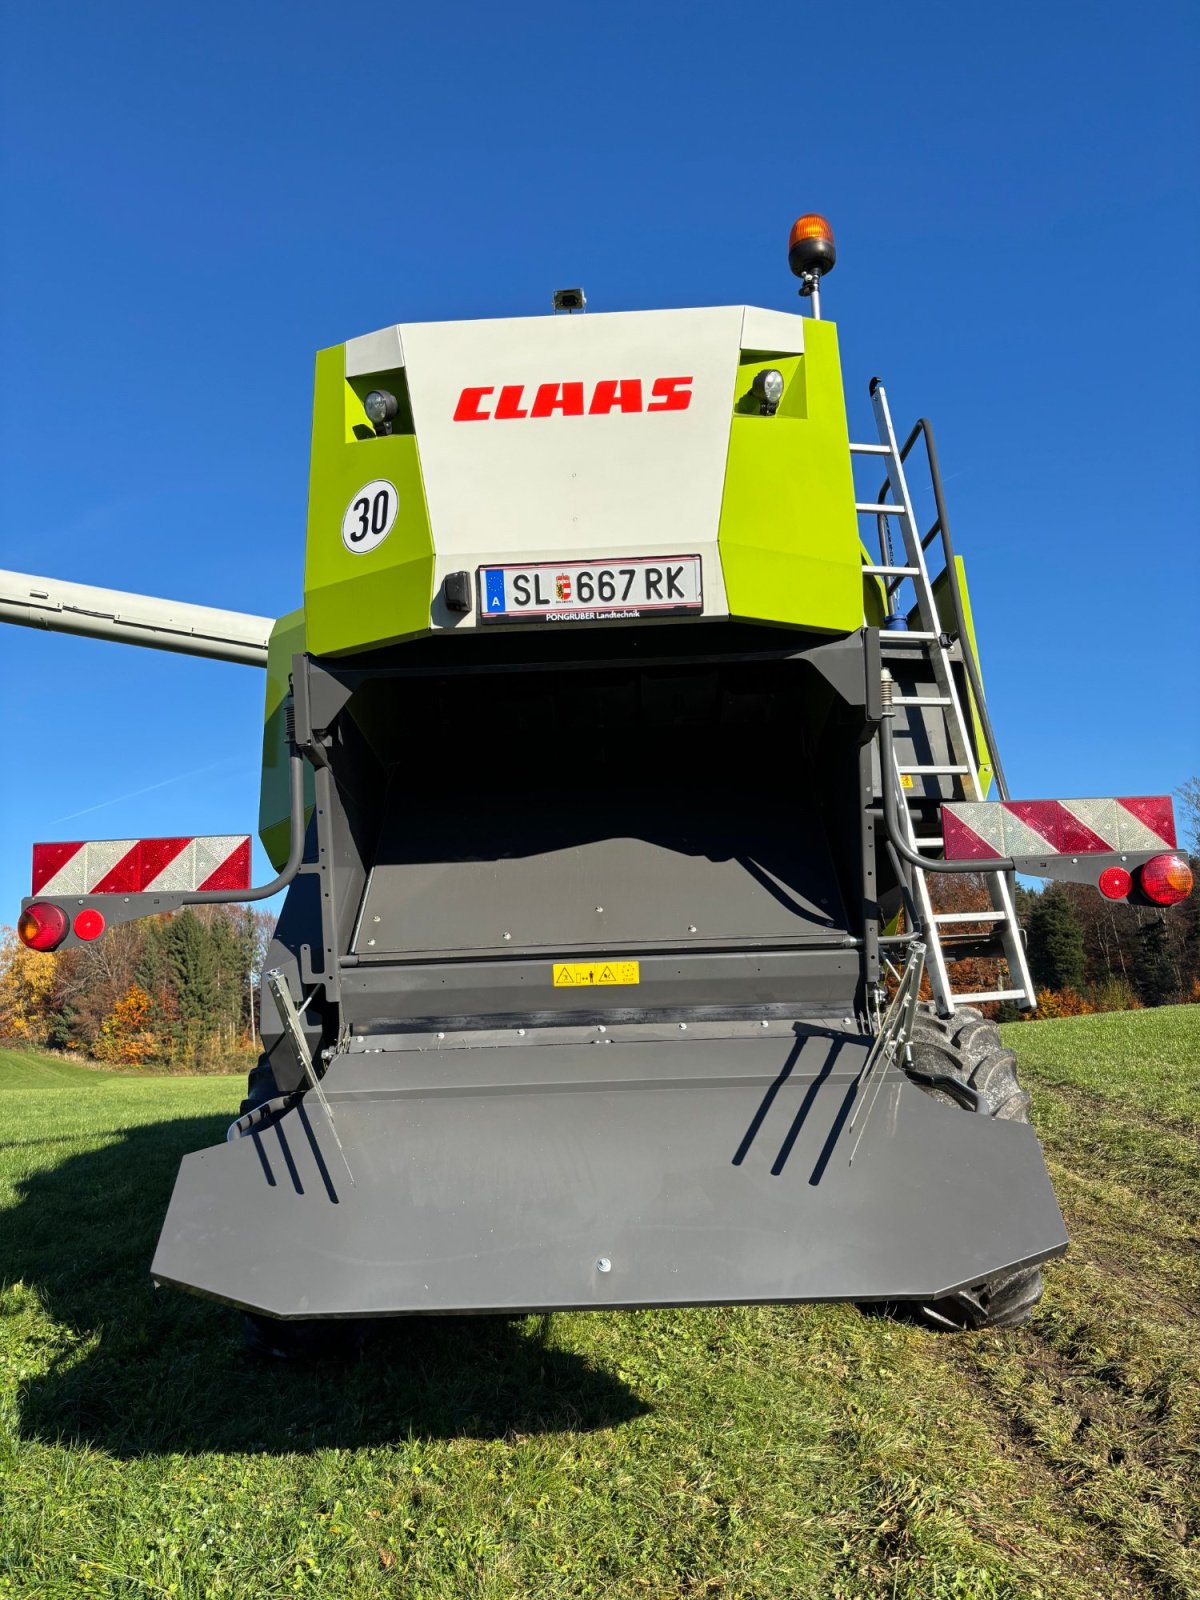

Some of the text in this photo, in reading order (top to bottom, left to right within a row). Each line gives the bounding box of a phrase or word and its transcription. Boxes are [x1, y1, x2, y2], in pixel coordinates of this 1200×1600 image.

[453, 376, 693, 422] CLAAS
[350, 490, 389, 543] 30
[491, 596, 501, 607] A
[513, 566, 685, 605] SL 667 RK
[546, 610, 640, 621] PONGRUBER Landtechnik
